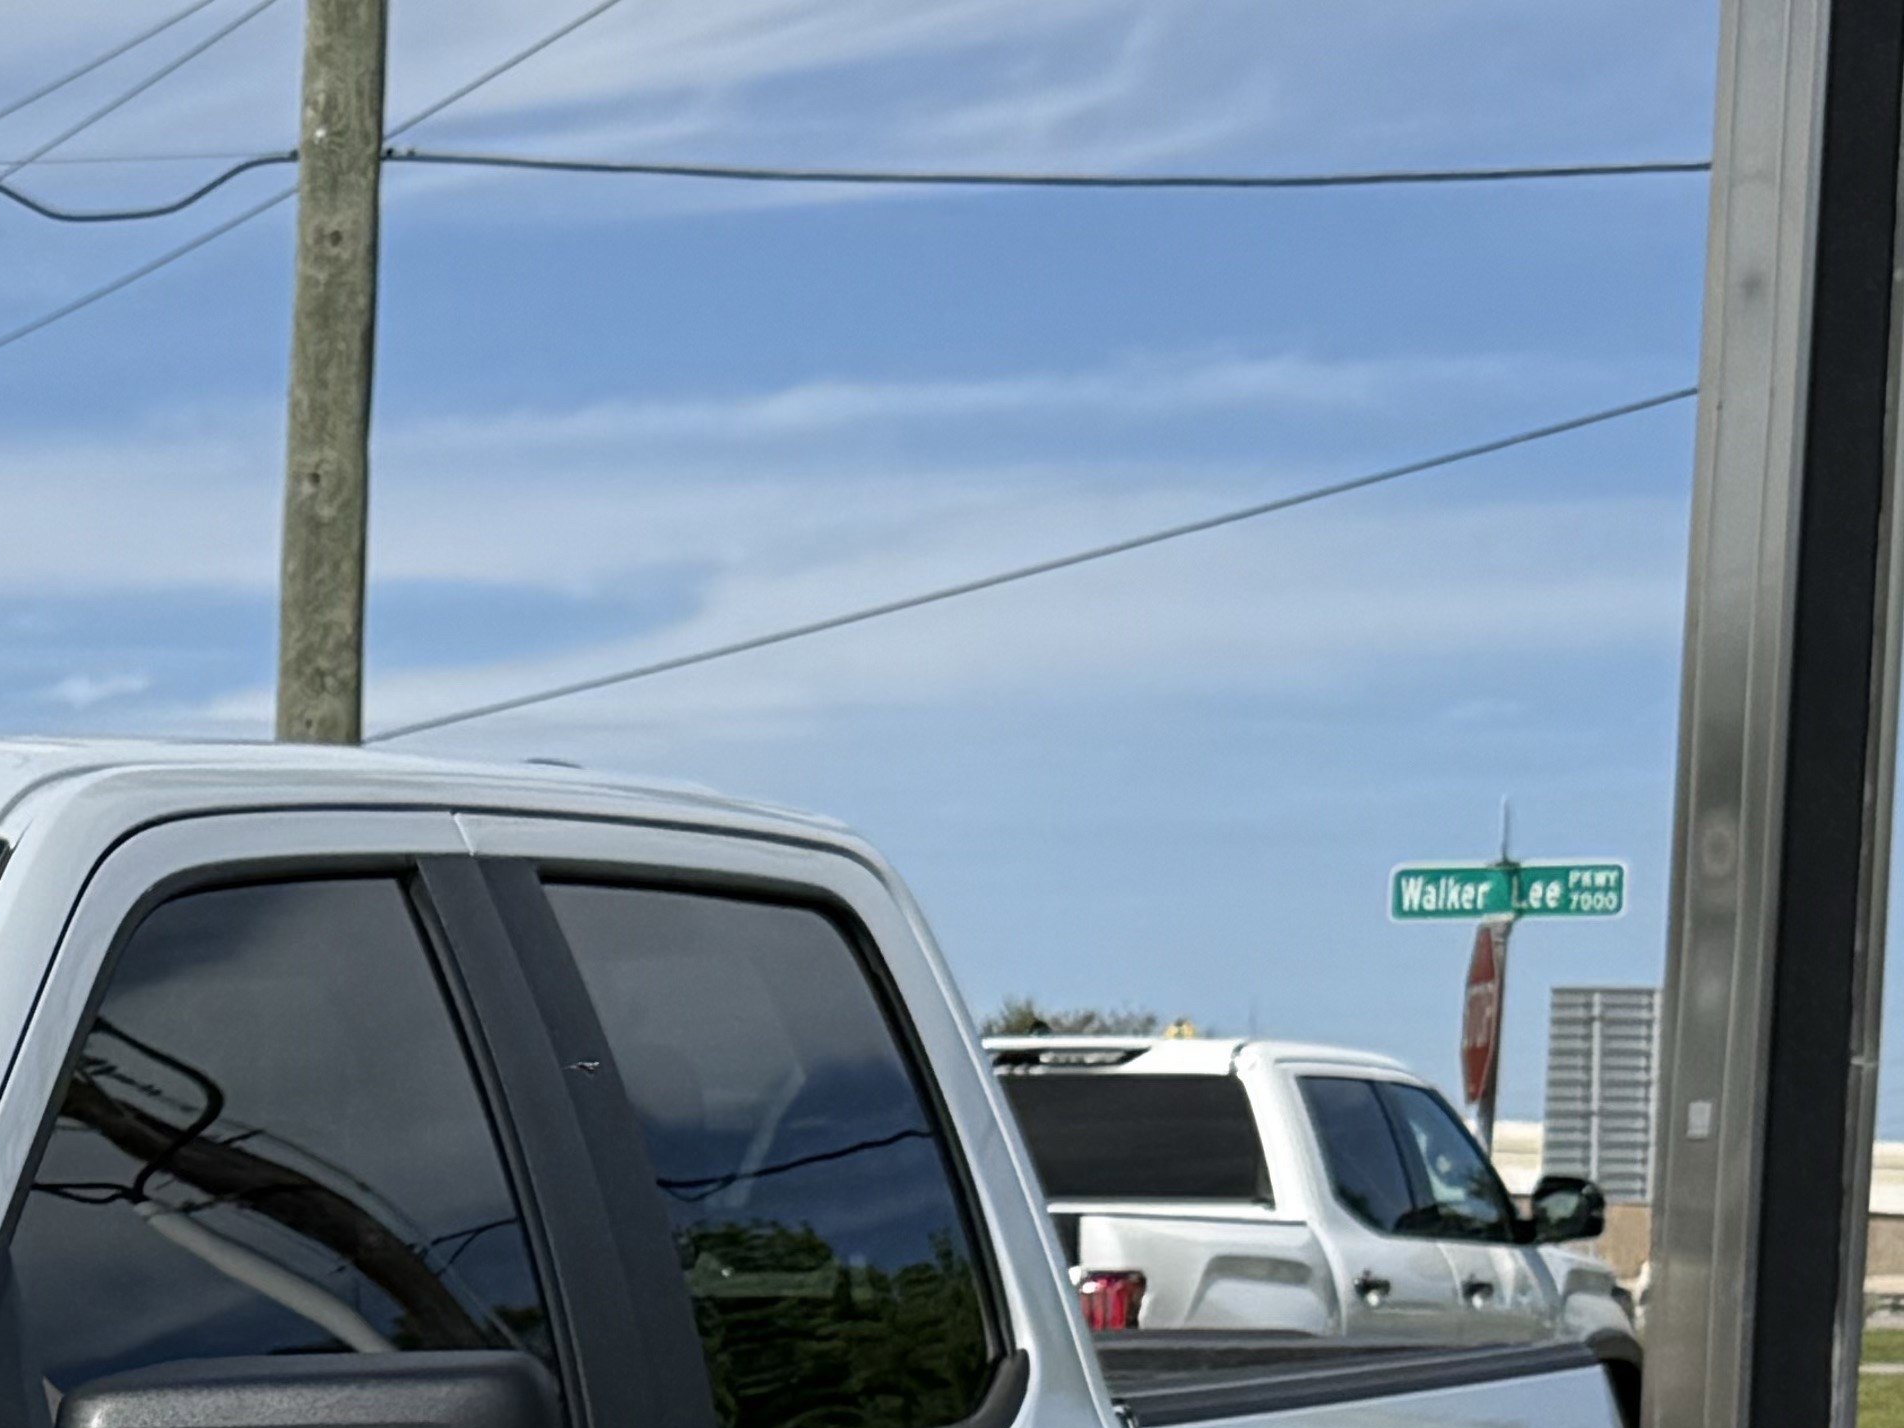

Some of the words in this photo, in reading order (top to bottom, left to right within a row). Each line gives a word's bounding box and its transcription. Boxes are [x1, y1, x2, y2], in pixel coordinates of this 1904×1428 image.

[1568, 869, 1619, 889] PKWY
[1400, 875, 1491, 912] Walker
[1510, 875, 1562, 910] Lee
[1569, 891, 1618, 911] 7000
